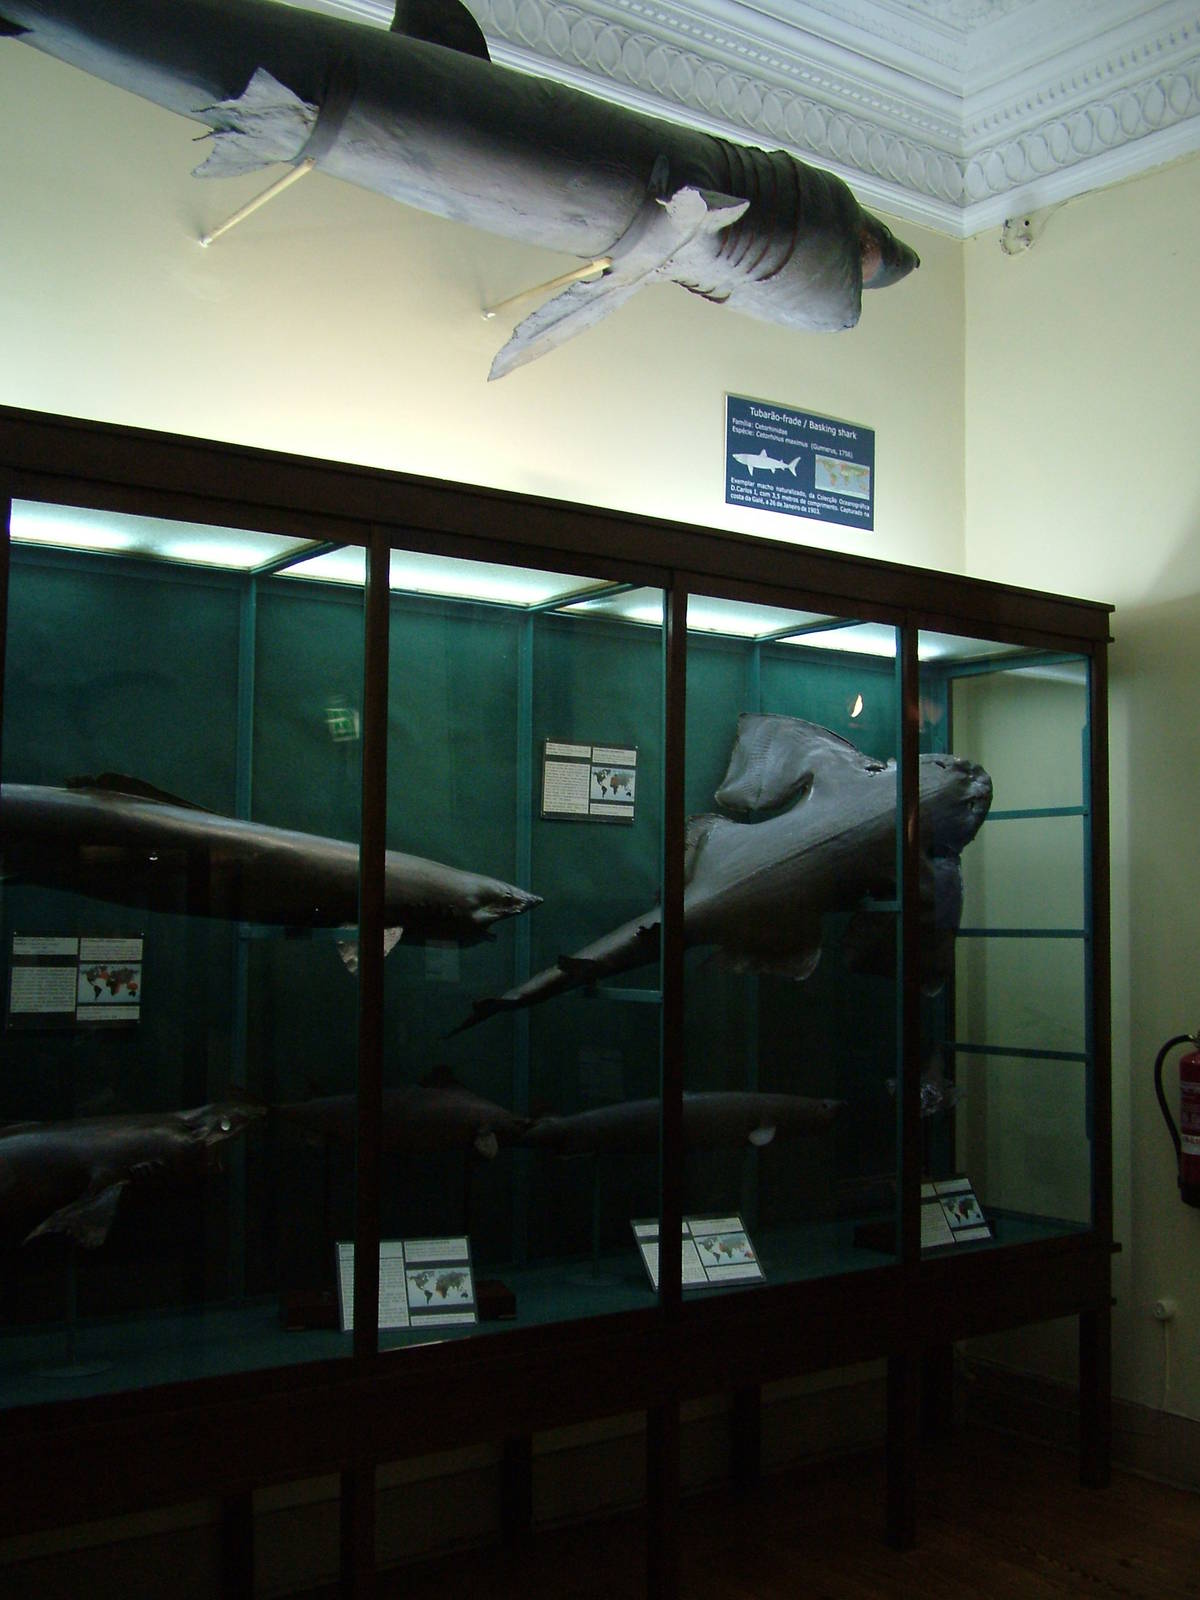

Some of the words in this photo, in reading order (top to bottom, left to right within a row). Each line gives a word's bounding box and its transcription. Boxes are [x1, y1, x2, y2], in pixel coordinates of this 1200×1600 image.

[749, 406, 802, 426] Tubarão-frade
[803, 419, 808, 428] /
[809, 421, 836, 437] Basking
[838, 427, 857, 440] shark
